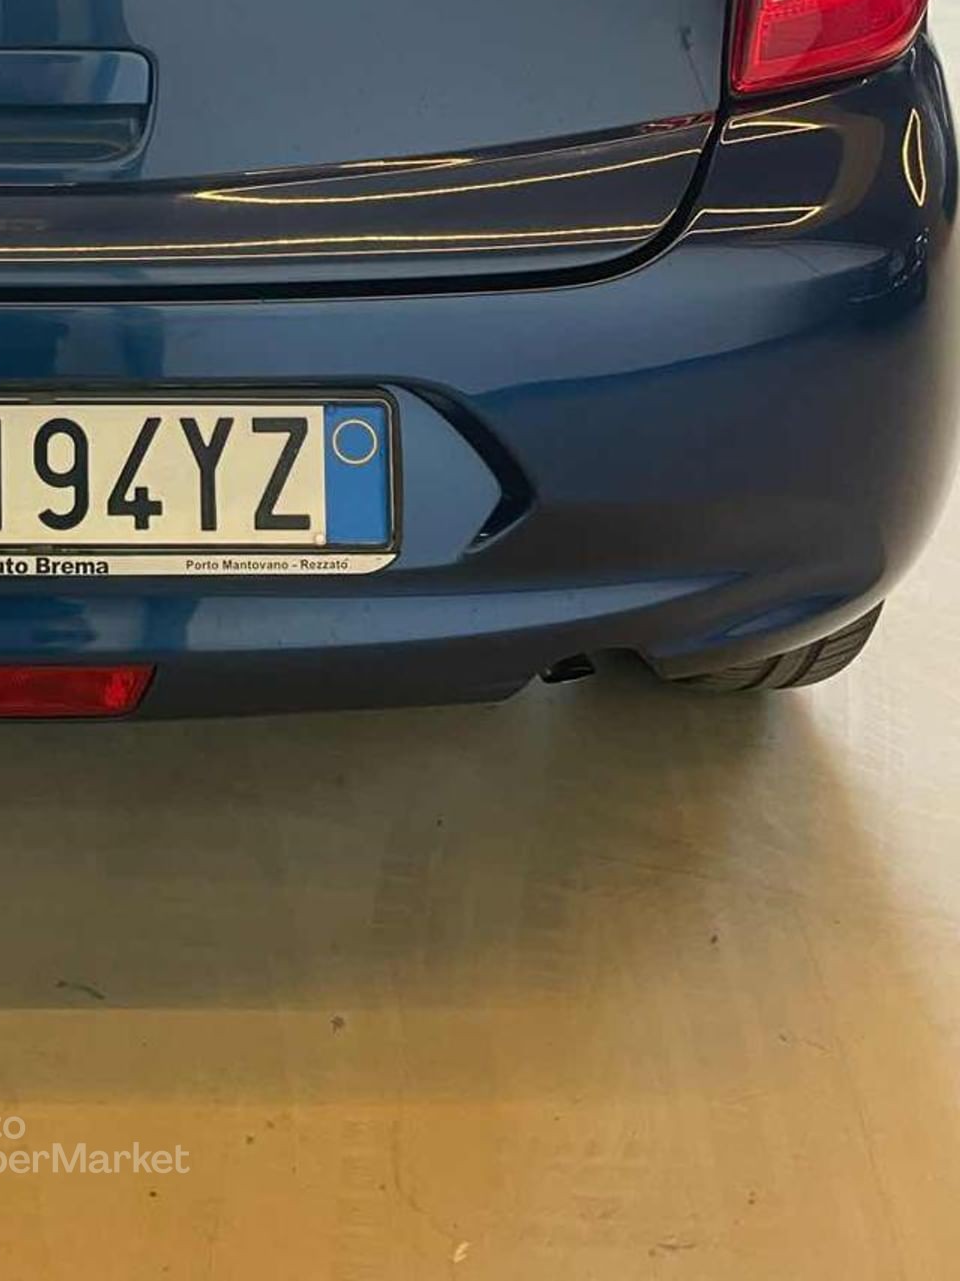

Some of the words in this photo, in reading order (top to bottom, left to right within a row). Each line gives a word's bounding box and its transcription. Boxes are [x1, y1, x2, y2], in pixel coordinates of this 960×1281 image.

[35, 556, 110, 574] Brema
[186, 560, 219, 570] Porto
[222, 560, 289, 571] Mantovano
[300, 558, 348, 570] Rezzato
